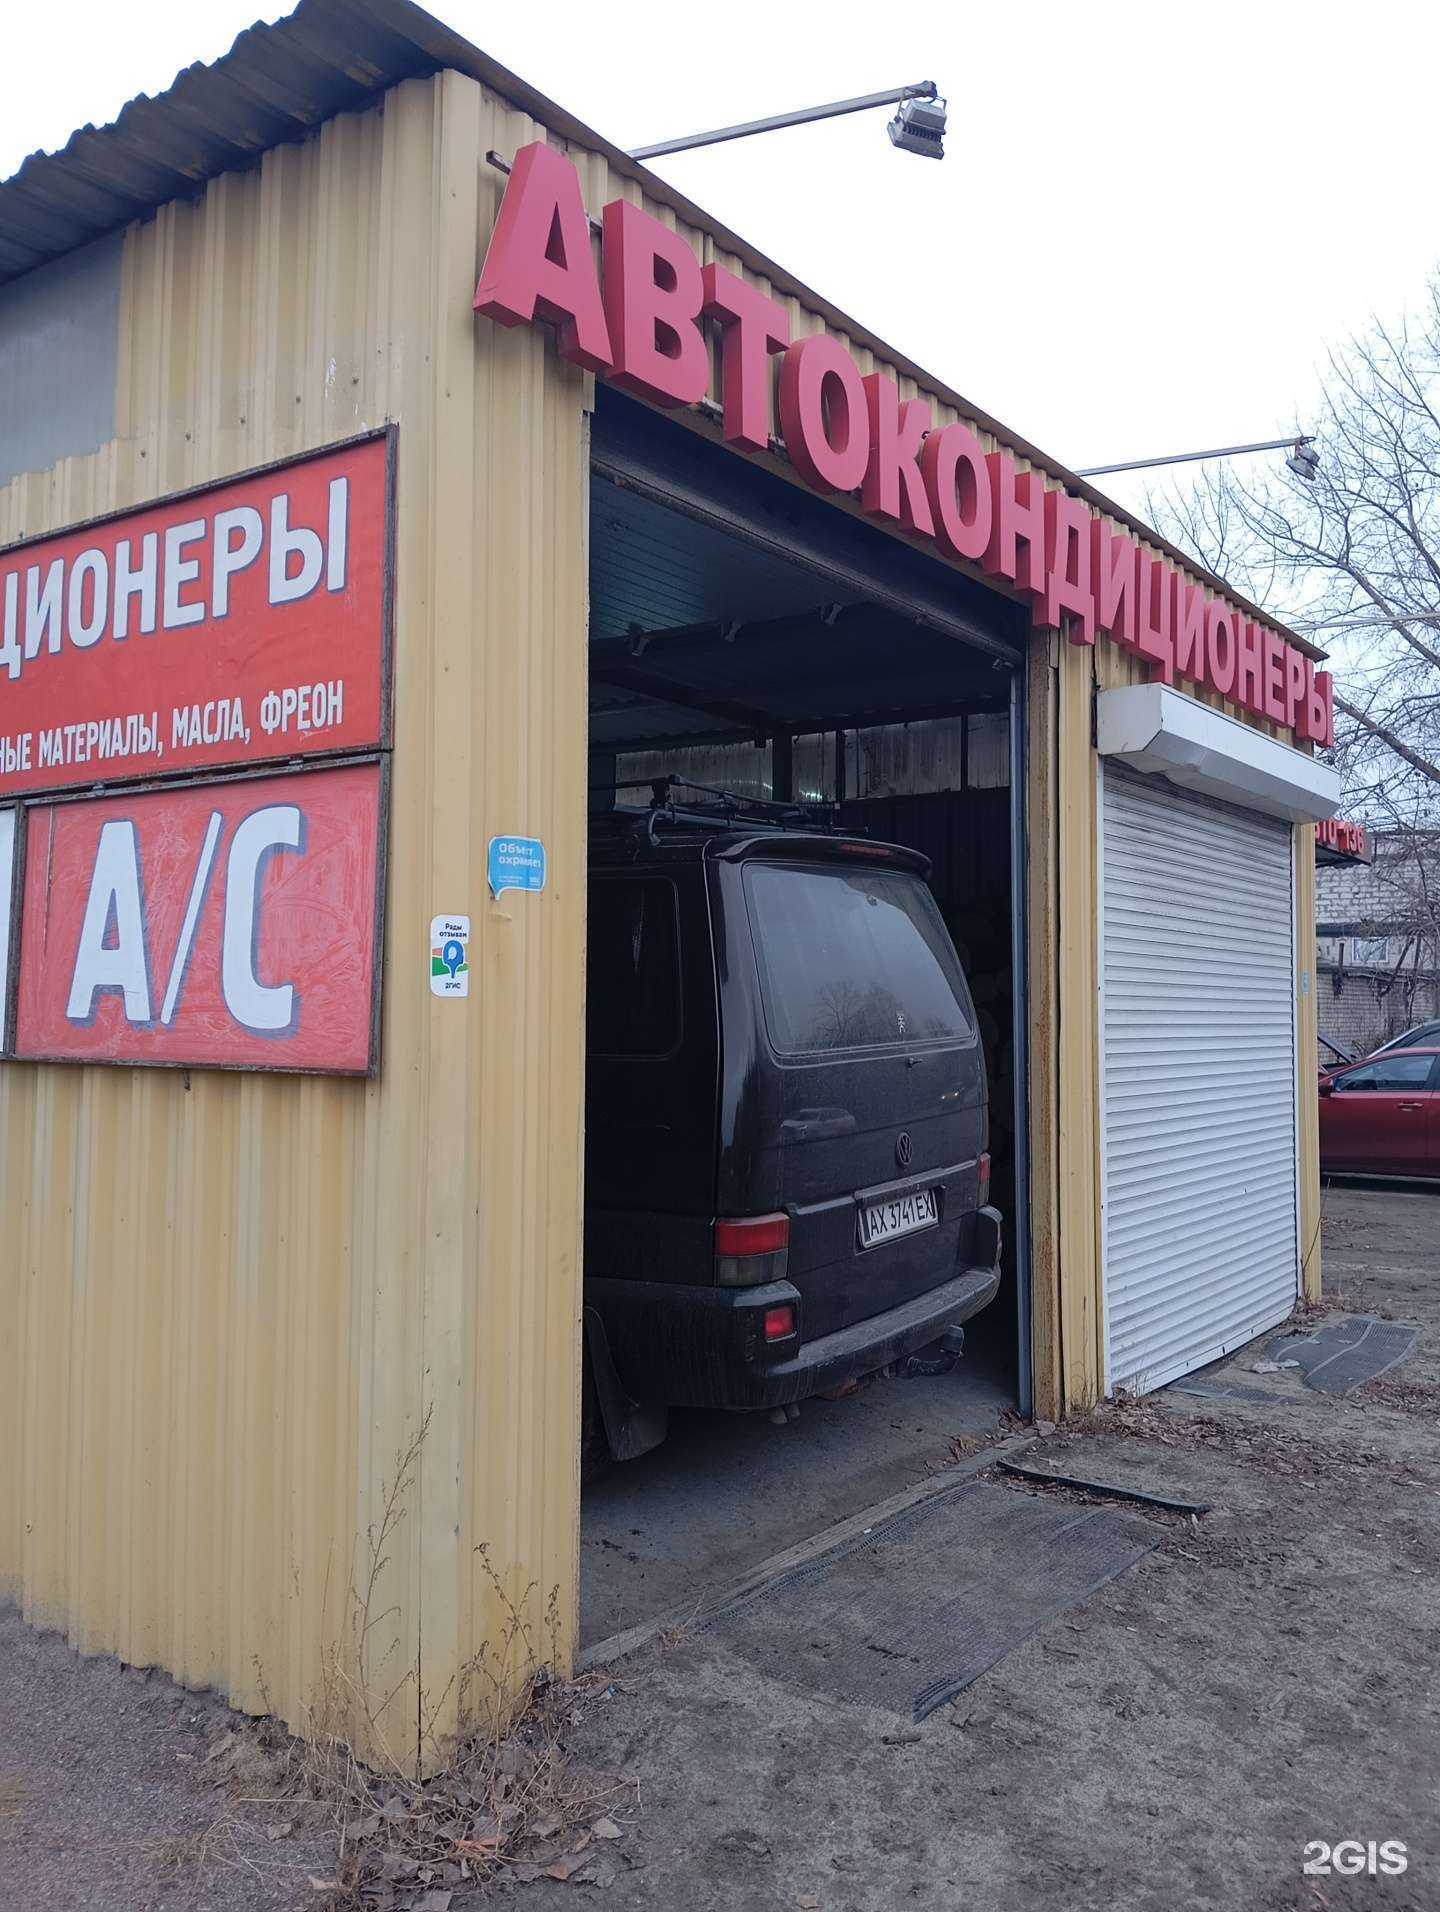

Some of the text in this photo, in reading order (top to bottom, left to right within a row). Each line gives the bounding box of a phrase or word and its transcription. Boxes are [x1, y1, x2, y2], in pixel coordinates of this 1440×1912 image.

[473, 141, 1334, 748] АВТОКОНДИЦИОНЕРЫ
[39, 712, 163, 768] МАТЕРИАЛЫ,
[172, 697, 251, 749] МАСЛА,
[260, 680, 344, 735] ФРЕОН
